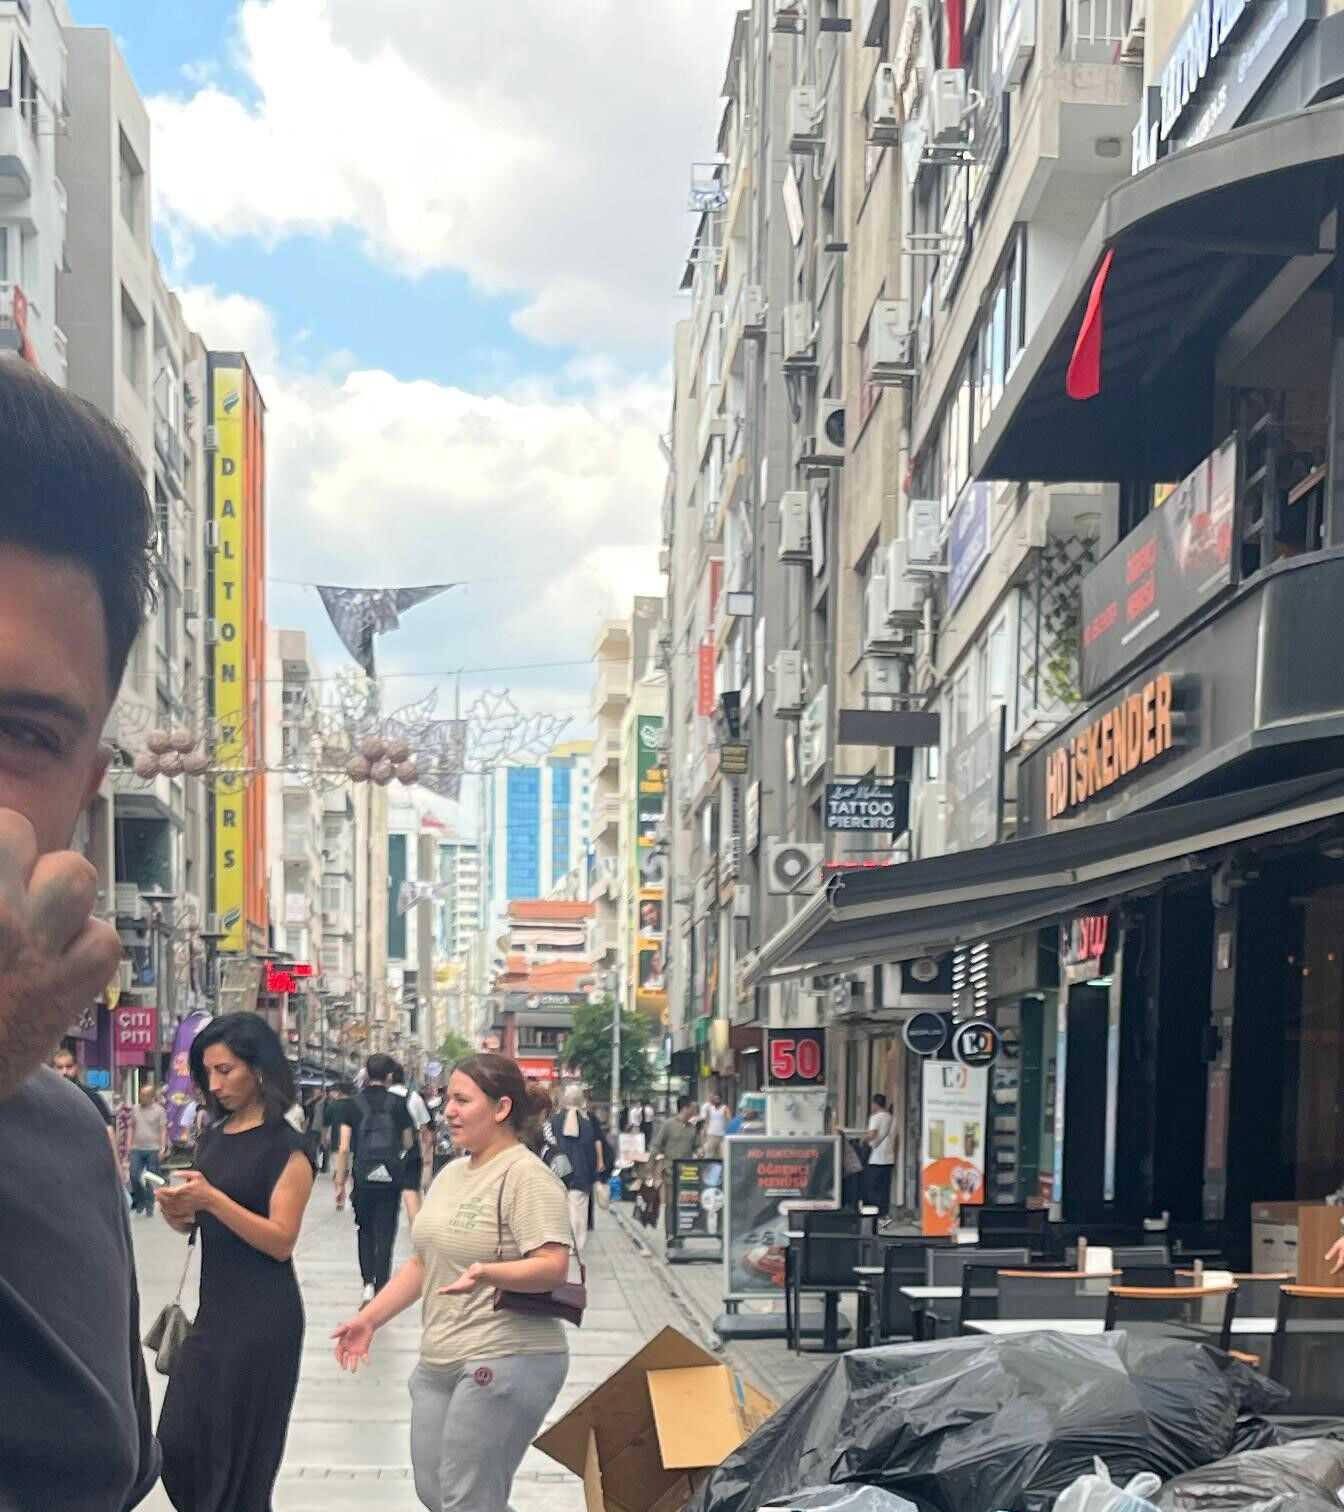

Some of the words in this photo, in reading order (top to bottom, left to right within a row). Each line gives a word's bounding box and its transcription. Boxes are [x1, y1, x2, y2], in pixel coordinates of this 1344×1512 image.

[221, 457, 236, 684] DALTON
[1046, 746, 1068, 820] HD
[828, 815, 896, 829] PIERCING
[829, 801, 895, 816] TATTOO
[770, 1038, 821, 1080] 50
